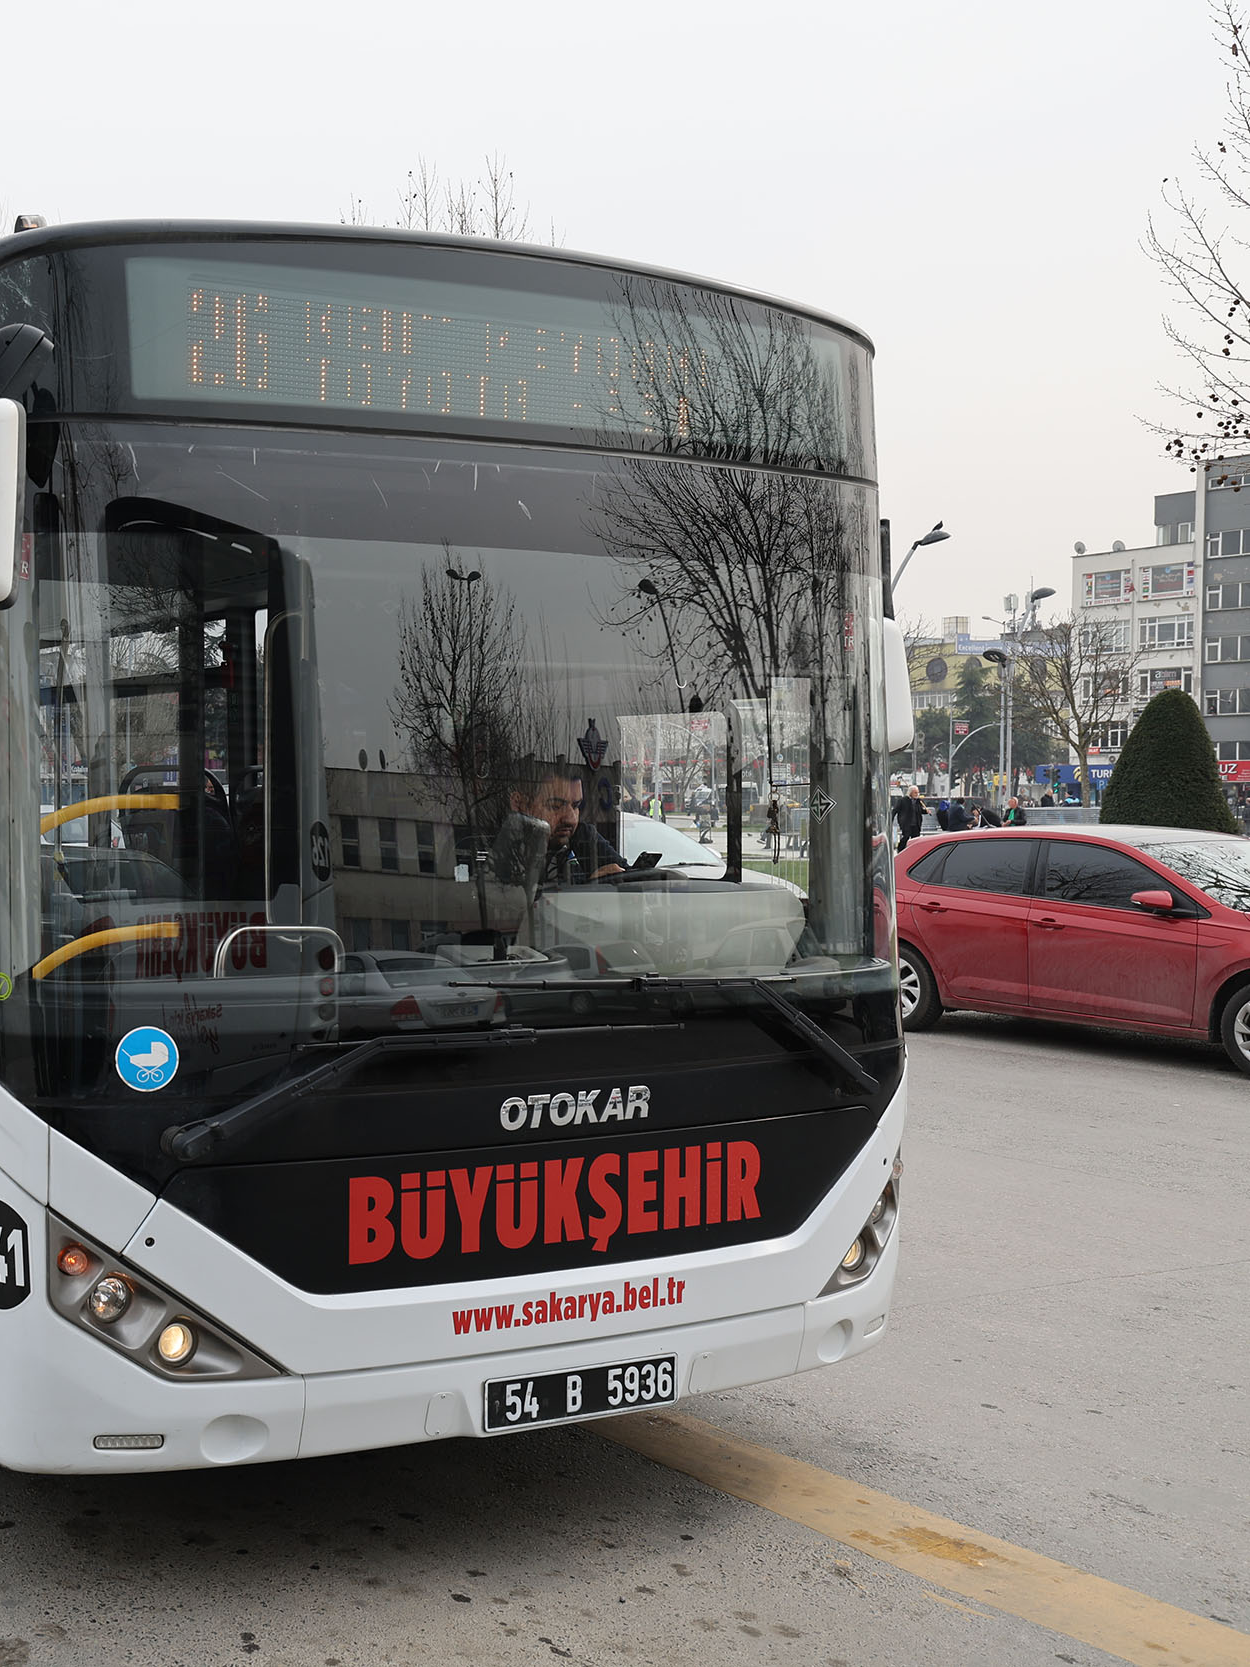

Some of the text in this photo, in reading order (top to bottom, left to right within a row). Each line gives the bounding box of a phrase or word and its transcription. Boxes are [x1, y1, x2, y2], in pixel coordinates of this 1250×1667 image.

[192, 288, 268, 389] 26
[500, 1085, 651, 1131] OTOKAR
[349, 1140, 762, 1265] BÜYÜKŞEHİR
[452, 1277, 687, 1336] www.sakarya.bel.tr
[505, 1361, 673, 1422] 54 B 5936
